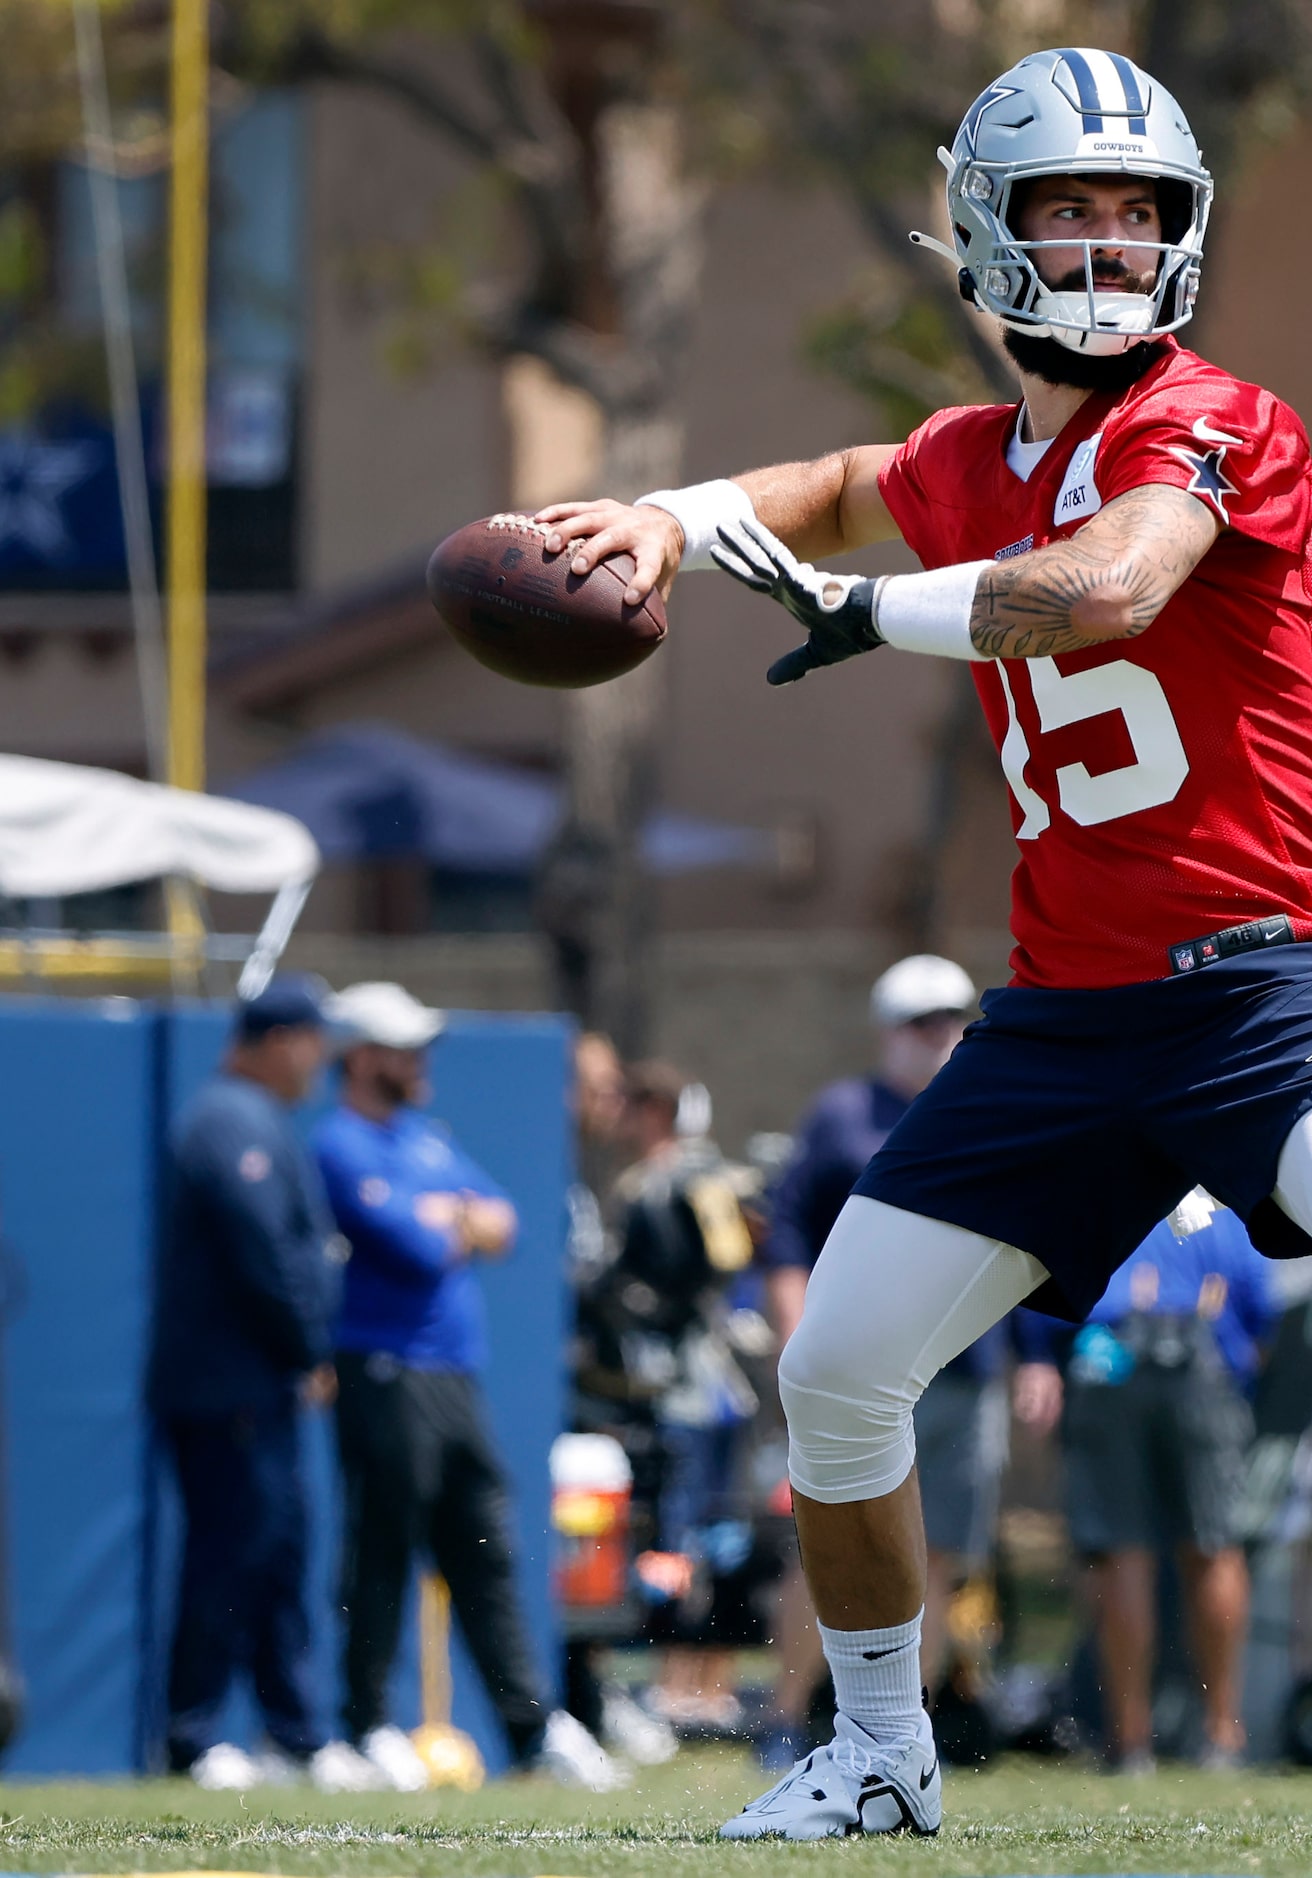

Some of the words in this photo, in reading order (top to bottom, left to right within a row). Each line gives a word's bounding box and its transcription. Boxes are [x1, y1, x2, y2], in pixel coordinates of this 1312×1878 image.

[1093, 142, 1144, 153] COWBOYS
[1061, 485, 1086, 511] AT&T
[477, 590, 524, 611] FOOTBALL
